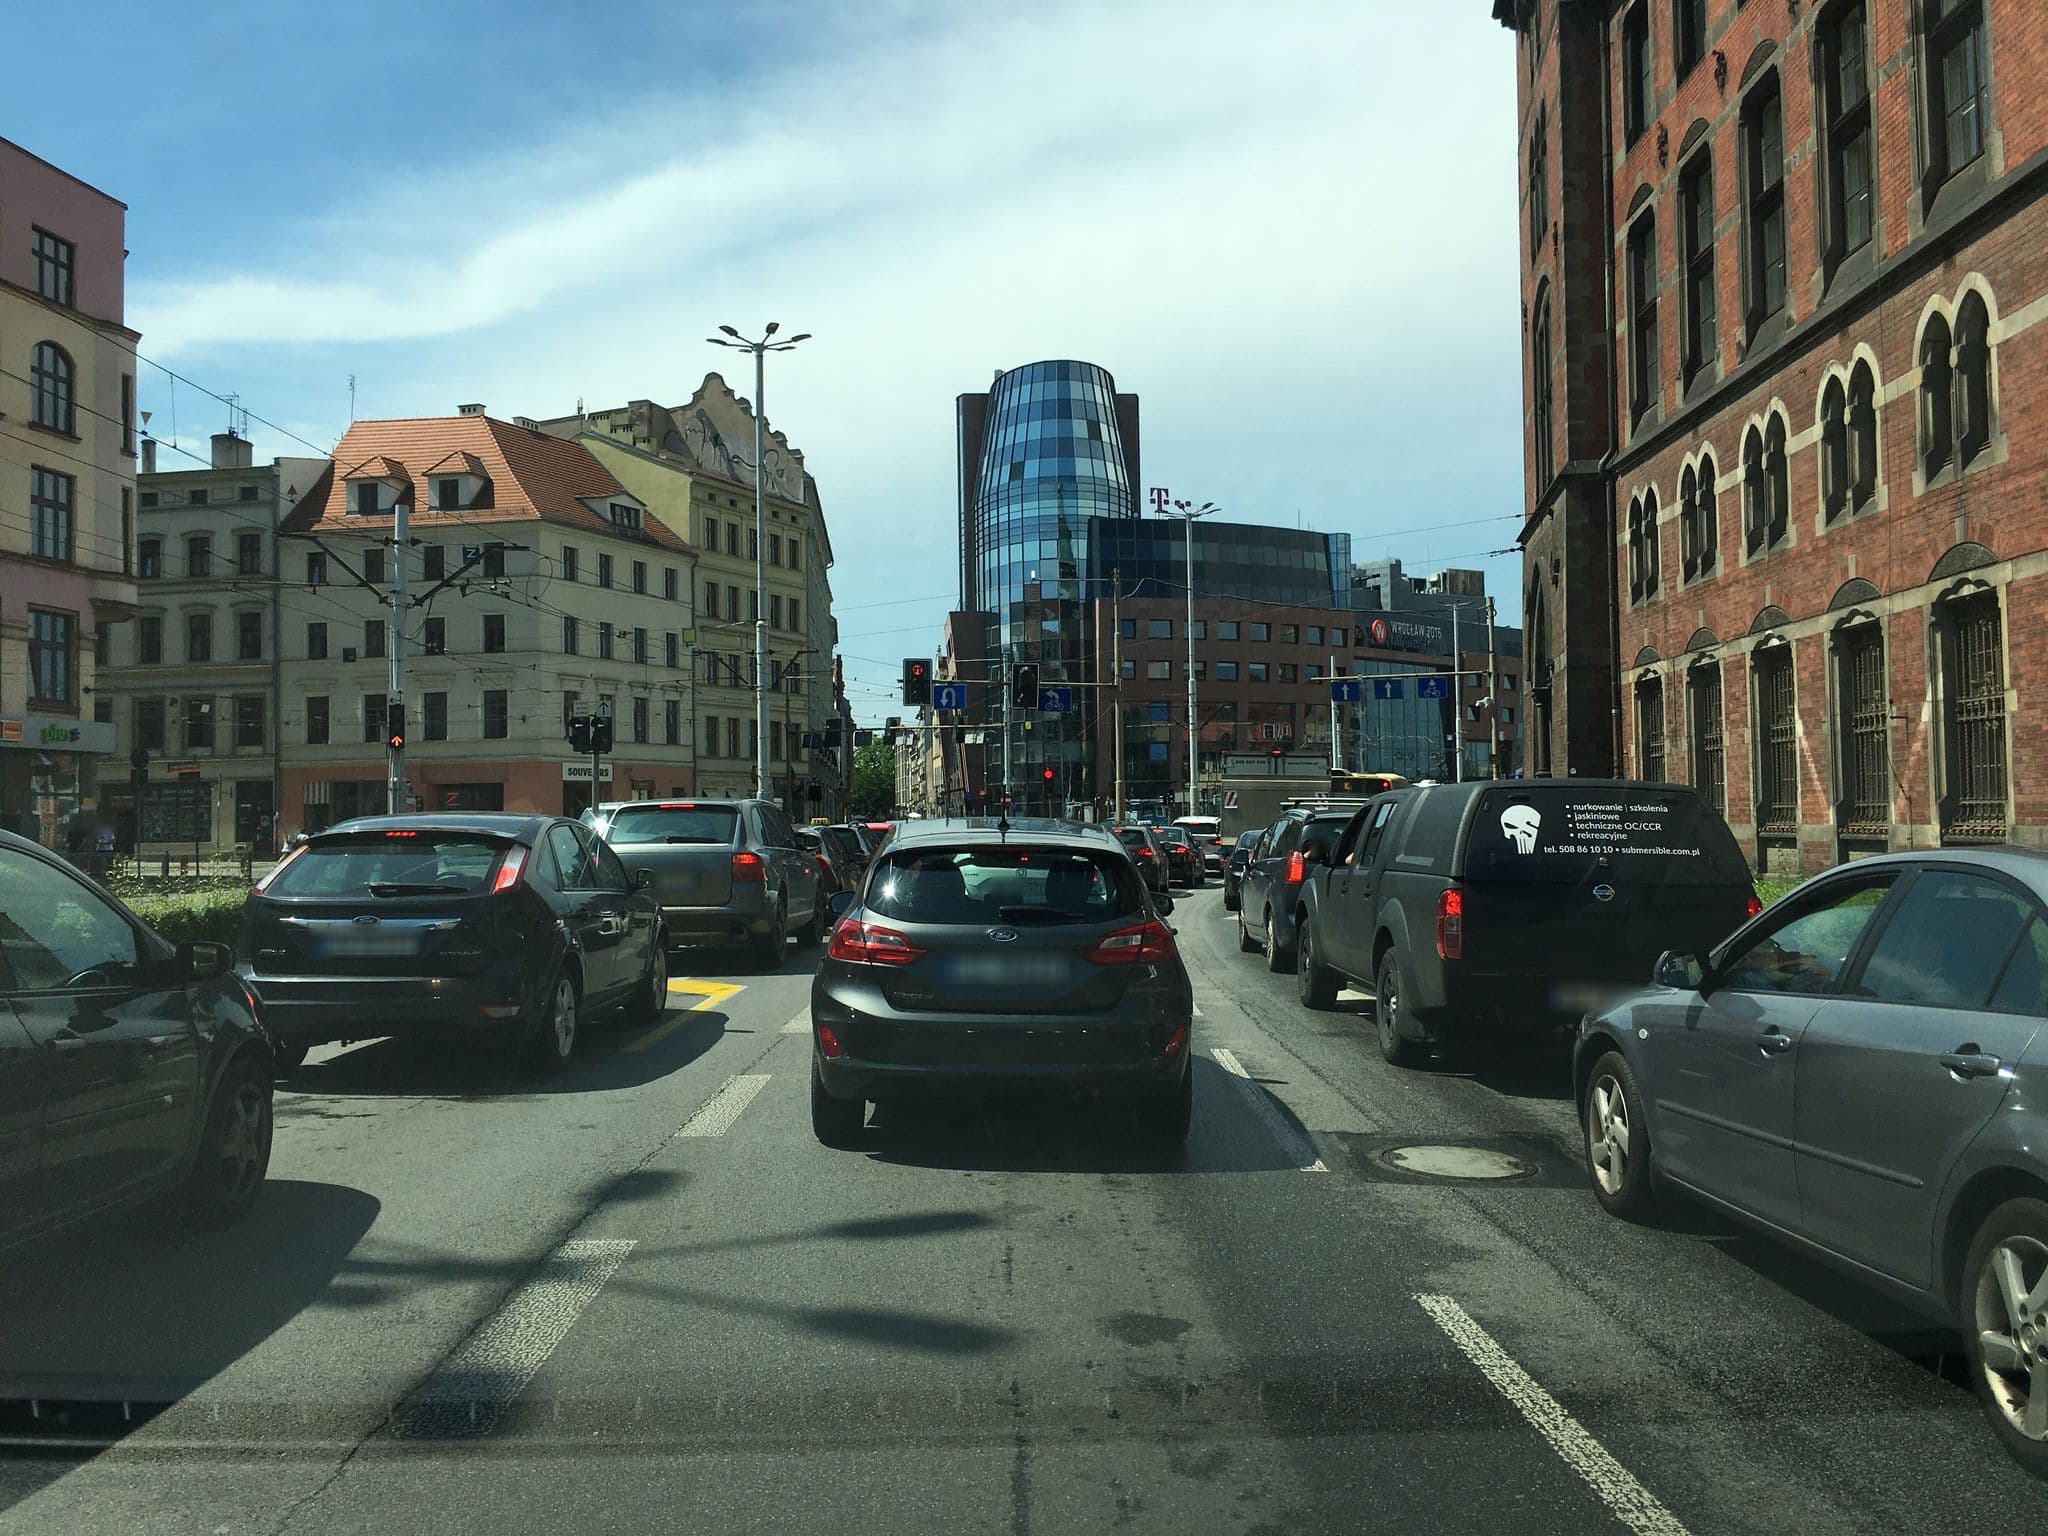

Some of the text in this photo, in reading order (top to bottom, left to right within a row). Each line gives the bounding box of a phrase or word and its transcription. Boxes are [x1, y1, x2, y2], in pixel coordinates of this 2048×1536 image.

[1150, 487, 1169, 513] T
[1390, 620, 1441, 640] WROCŁAW 2016
[567, 767, 609, 777] SOUVERS
[1572, 803, 1623, 812] nurkowanie
[1629, 804, 1668, 813] szkolenia
[1574, 812, 1620, 821] jaskiniowe
[1576, 822, 1662, 831] techniczne OC/CCR
[1577, 831, 1628, 841] rekreacyjne
[1544, 845, 1700, 857] tel. 508 86 10 10 submersible.com.pl
